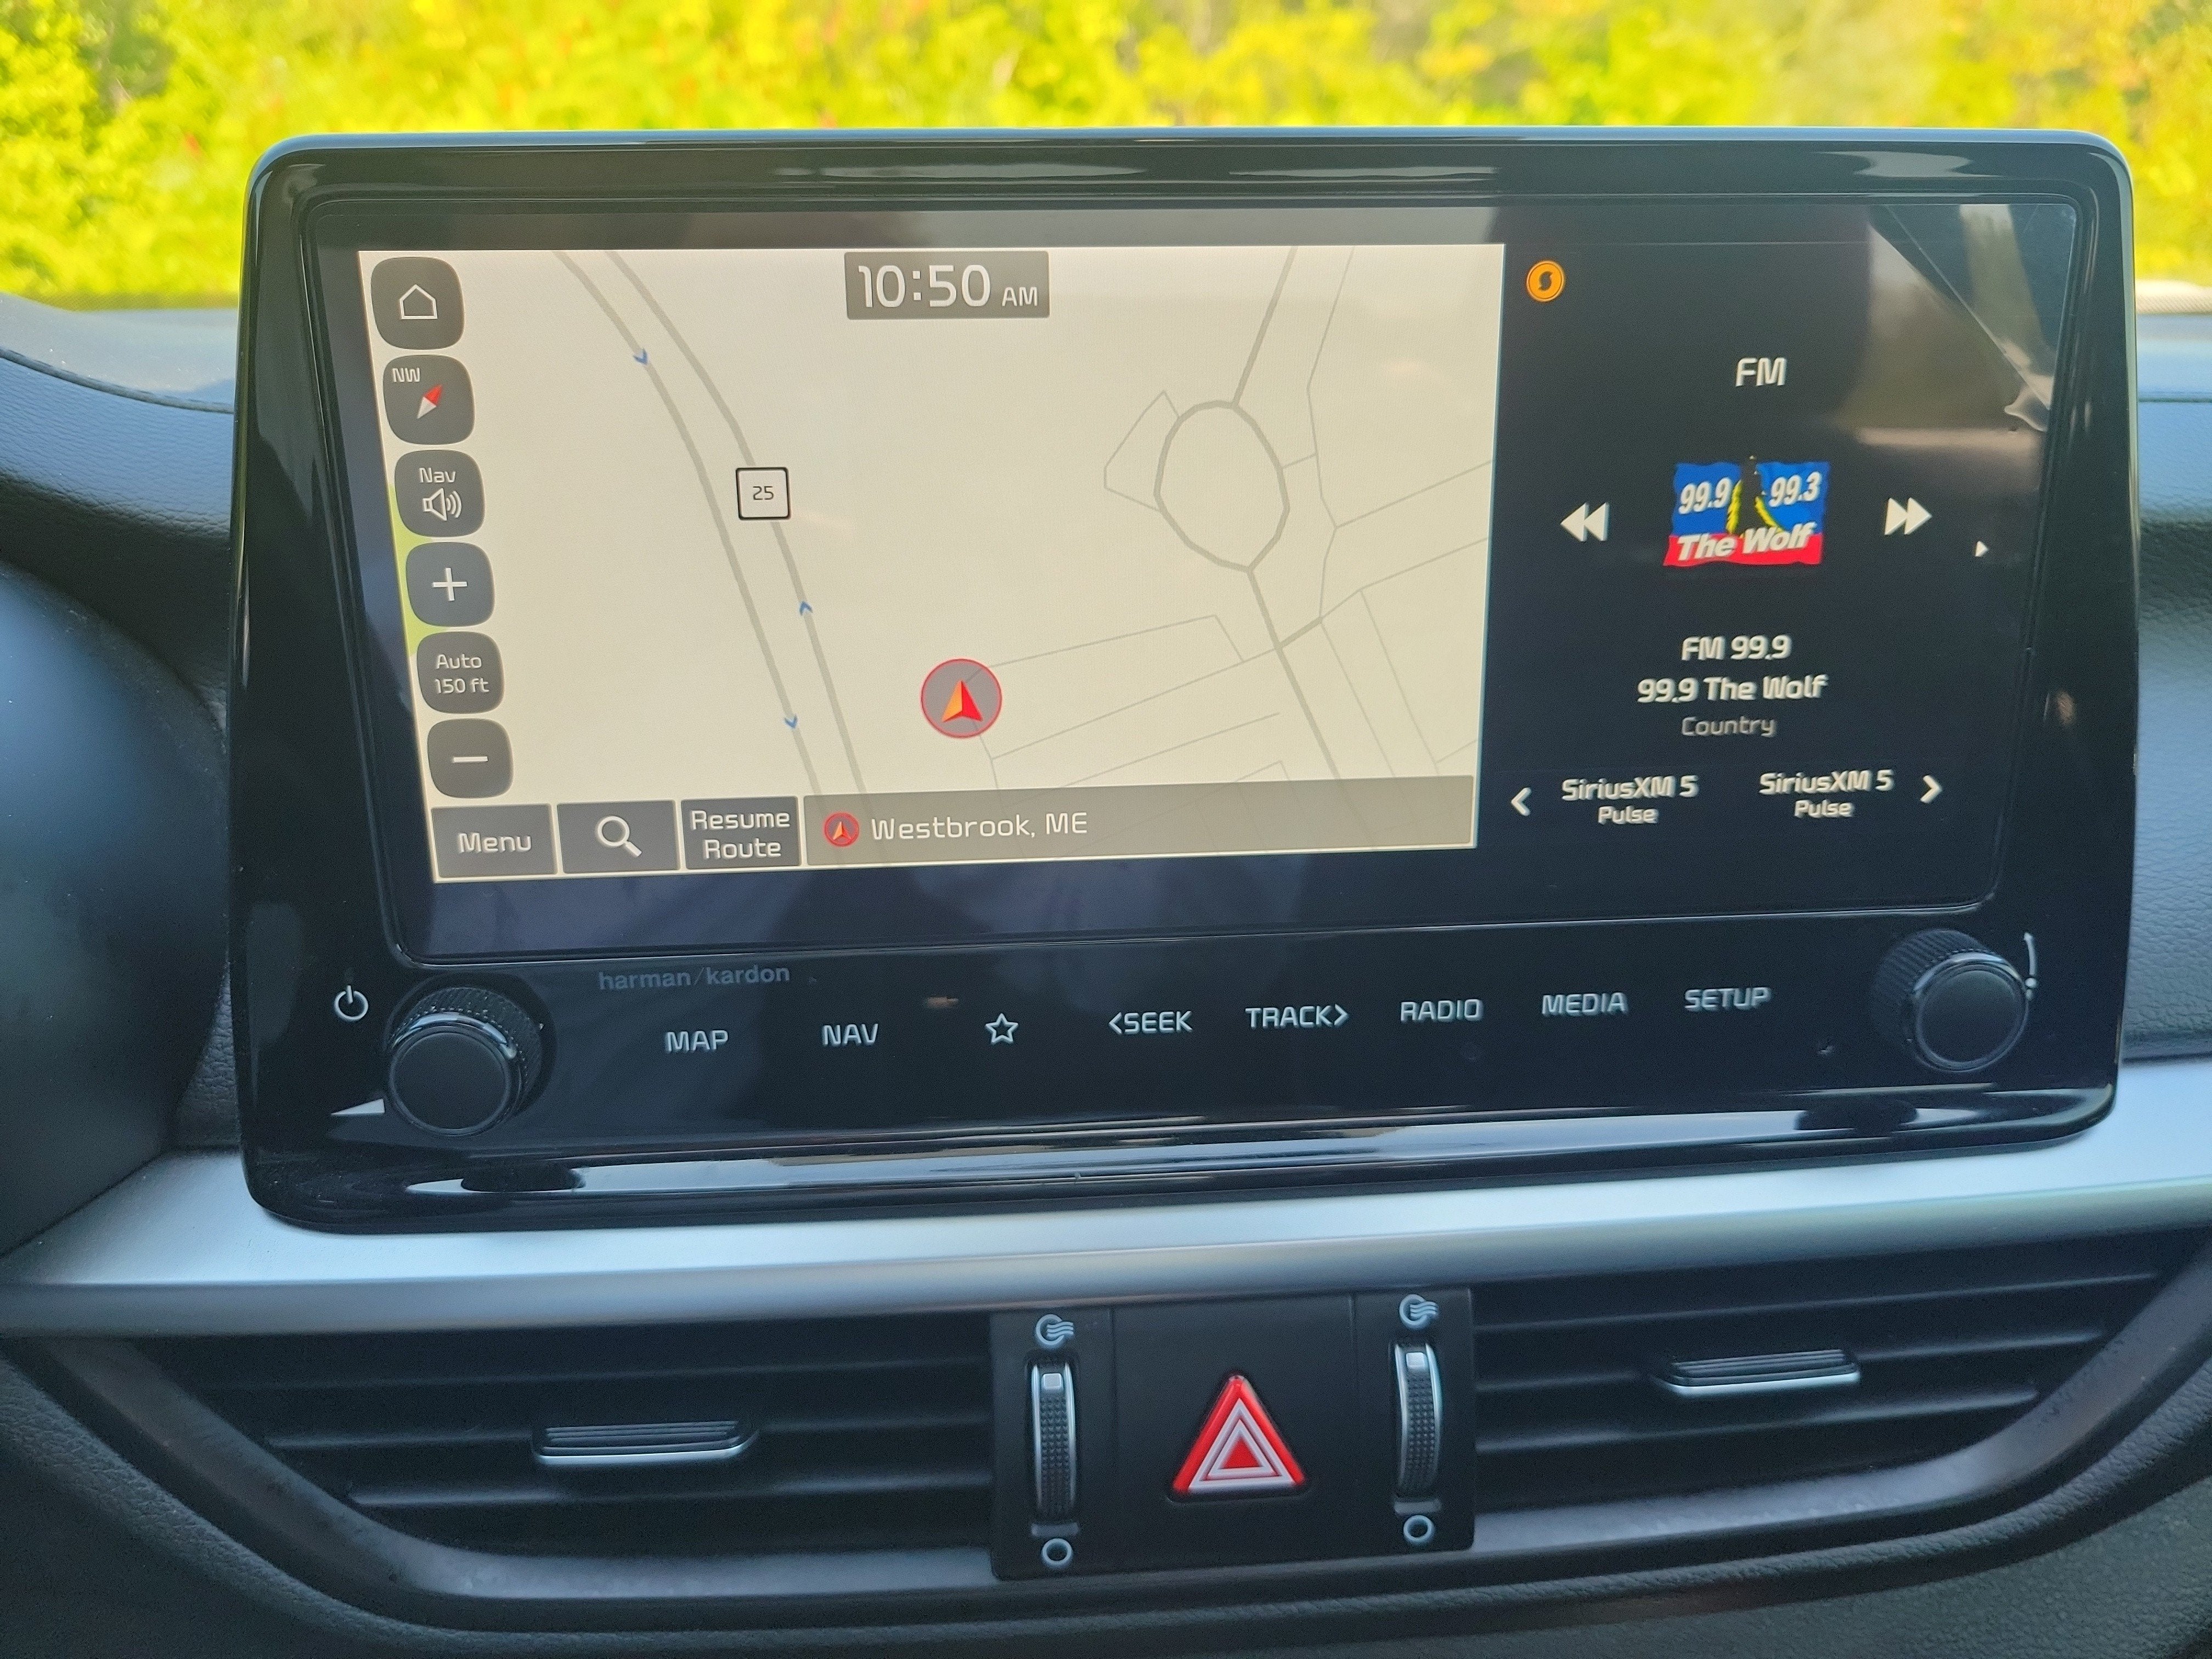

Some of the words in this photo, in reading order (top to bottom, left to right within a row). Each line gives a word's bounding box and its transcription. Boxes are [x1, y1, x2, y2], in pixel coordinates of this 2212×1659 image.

[858, 264, 991, 308] 10:50
[1002, 286, 1039, 307] AM
[392, 367, 421, 383] NW
[1735, 357, 1787, 387] FM
[419, 467, 456, 484] Nav
[752, 486, 774, 501] 25
[1678, 477, 1733, 514] 99.9
[1769, 471, 1822, 507] 99.3
[1677, 533, 1737, 561] The
[1742, 522, 1817, 554] Wolf
[1681, 635, 1724, 661] FM
[1730, 634, 1792, 661] 99.9
[436, 653, 482, 669] Auto
[435, 678, 466, 694] 150
[469, 678, 489, 693] ft
[1637, 678, 1699, 703] 99.9
[1703, 676, 1756, 702] The
[1762, 674, 1830, 699] Wolf
[1681, 715, 1777, 737] Country
[1561, 775, 1675, 802] SiriusXM
[1679, 775, 1699, 797] 5
[1759, 770, 1872, 795] SiriusXM
[1875, 769, 1894, 791] 5
[691, 810, 791, 831] Resume
[1598, 805, 1658, 825] Pulse
[1794, 799, 1854, 819] Pulse
[871, 814, 1036, 840] Westbrook,
[1045, 812, 1087, 834] ME
[458, 832, 532, 854] Menu
[703, 837, 782, 860] Route
[1400, 999, 1482, 1023] RADIO
[1542, 992, 1629, 1016] MEDIA
[1684, 987, 1772, 1013] SETUP
[665, 1030, 729, 1053] MAP
[821, 1023, 879, 1046] NAV
